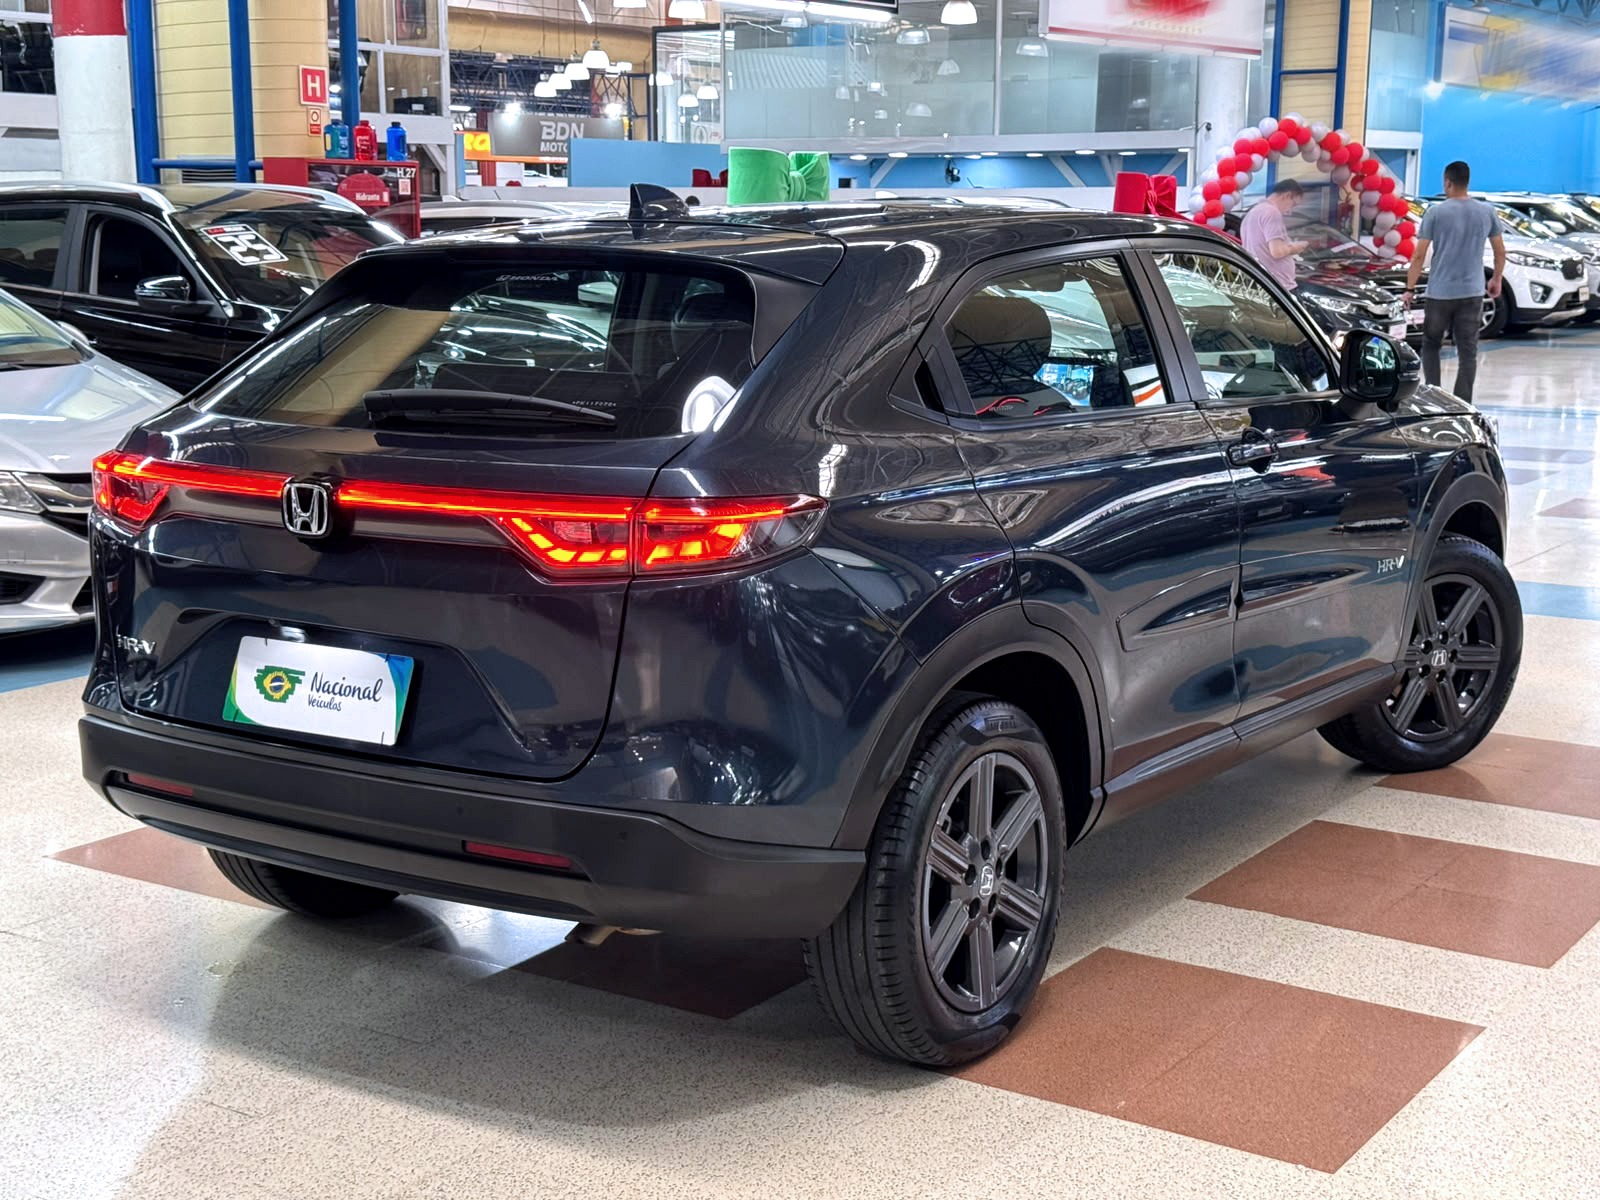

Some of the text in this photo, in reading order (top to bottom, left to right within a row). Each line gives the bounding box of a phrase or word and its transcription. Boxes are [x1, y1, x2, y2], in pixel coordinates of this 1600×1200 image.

[306, 74, 321, 98] H
[539, 120, 585, 140] BDN
[355, 192, 380, 202] Hidrante
[216, 233, 281, 263] 25
[1377, 555, 1405, 574] HR-V
[116, 633, 156, 655] HR-V
[310, 671, 383, 702] Nacional
[307, 694, 342, 711] Veículos
